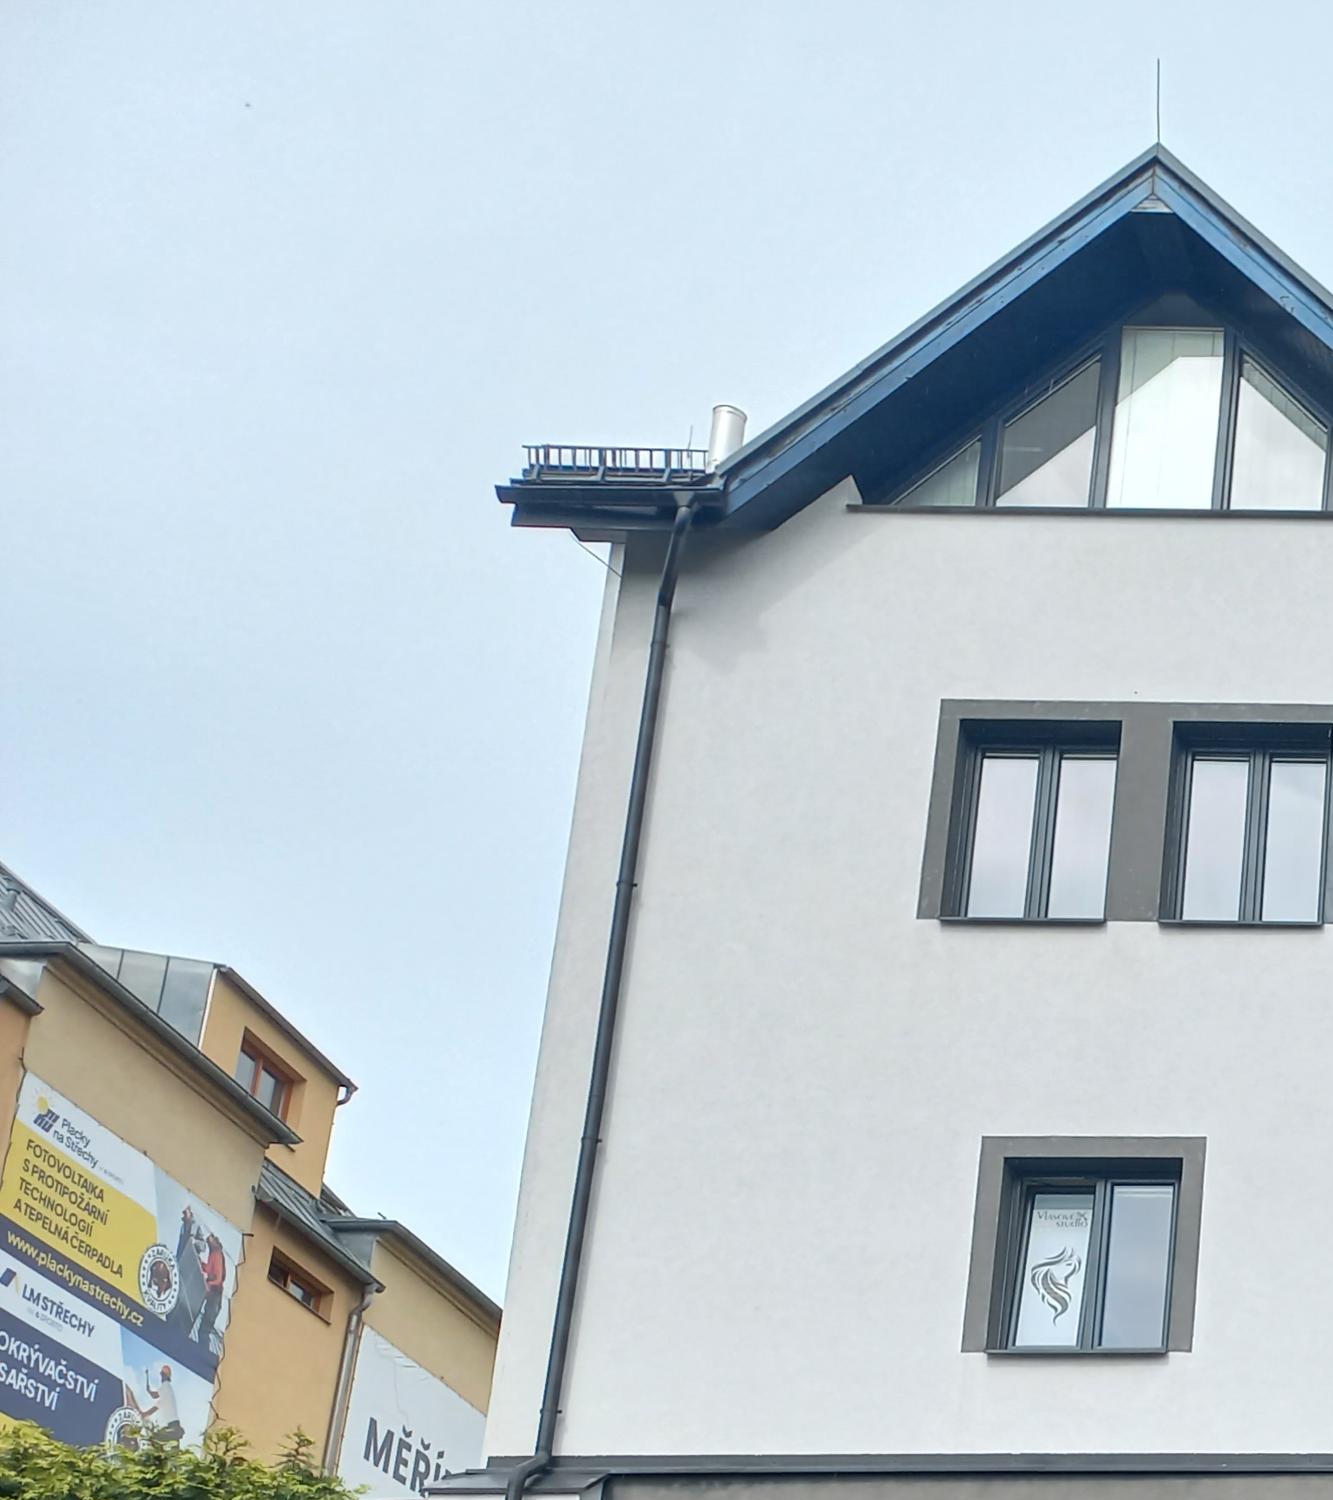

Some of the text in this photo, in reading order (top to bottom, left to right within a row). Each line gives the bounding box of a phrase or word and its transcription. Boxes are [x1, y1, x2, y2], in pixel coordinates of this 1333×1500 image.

[52, 1130, 99, 1168] na Střechy
[61, 1118, 91, 1148] Placky
[22, 1158, 30, 1172] S
[31, 1164, 110, 1225] PROTIPOŽÁRNÍ
[26, 1139, 104, 1202] FOTOVOLTAIKA
[13, 1198, 124, 1278] A TEPELNÁ ČERPADLA
[20, 1176, 95, 1237] TECHNOLOGIÍ
[7, 1230, 143, 1326] www.plackynastrechy.cz
[22, 1283, 42, 1307] LM
[41, 1296, 95, 1338] STŘECHY
[363, 1416, 451, 1496] MĚŘÍ
